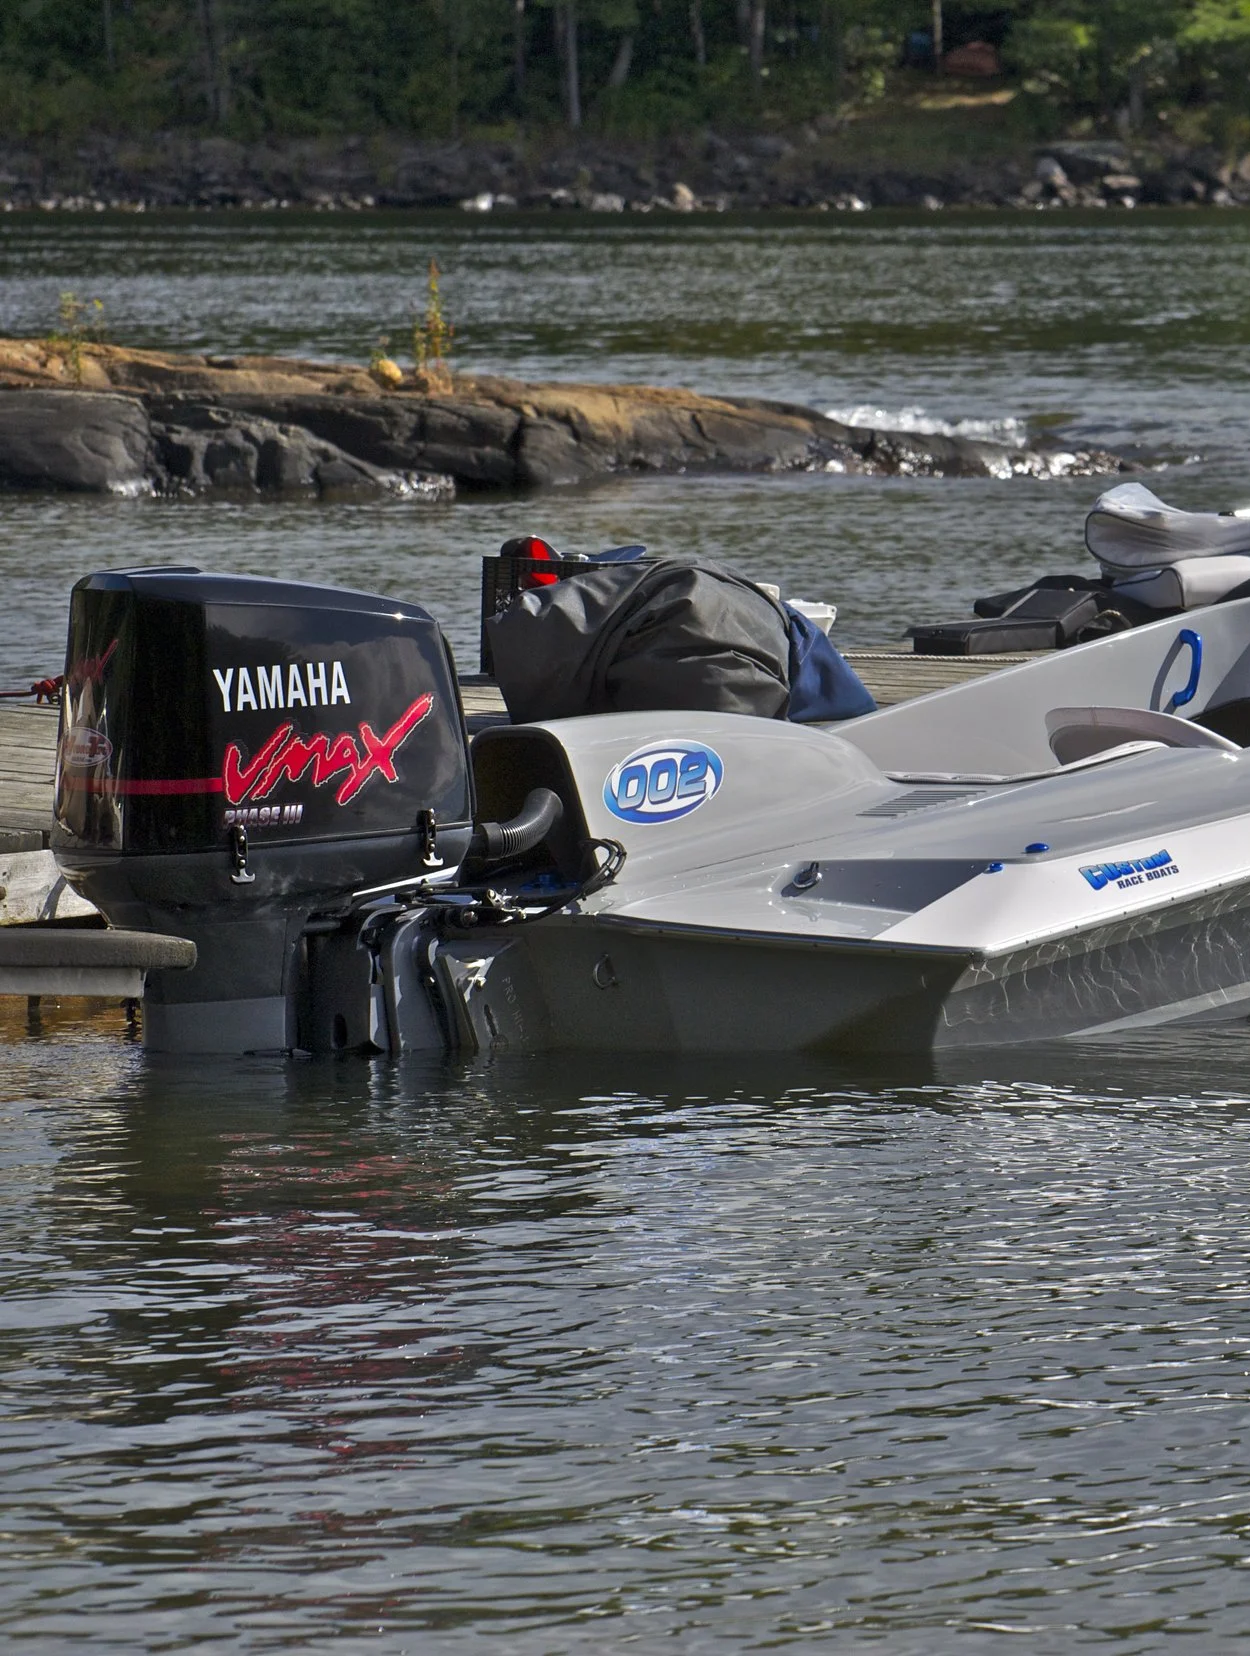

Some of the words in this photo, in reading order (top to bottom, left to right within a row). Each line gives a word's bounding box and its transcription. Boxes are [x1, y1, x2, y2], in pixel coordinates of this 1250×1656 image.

[213, 661, 351, 712] YAMAHA
[617, 751, 709, 811] 002
[223, 805, 281, 828] PHASE
[1078, 849, 1173, 891] CUSTOM
[1116, 874, 1145, 890] RACE
[1145, 864, 1180, 882] BOATS
